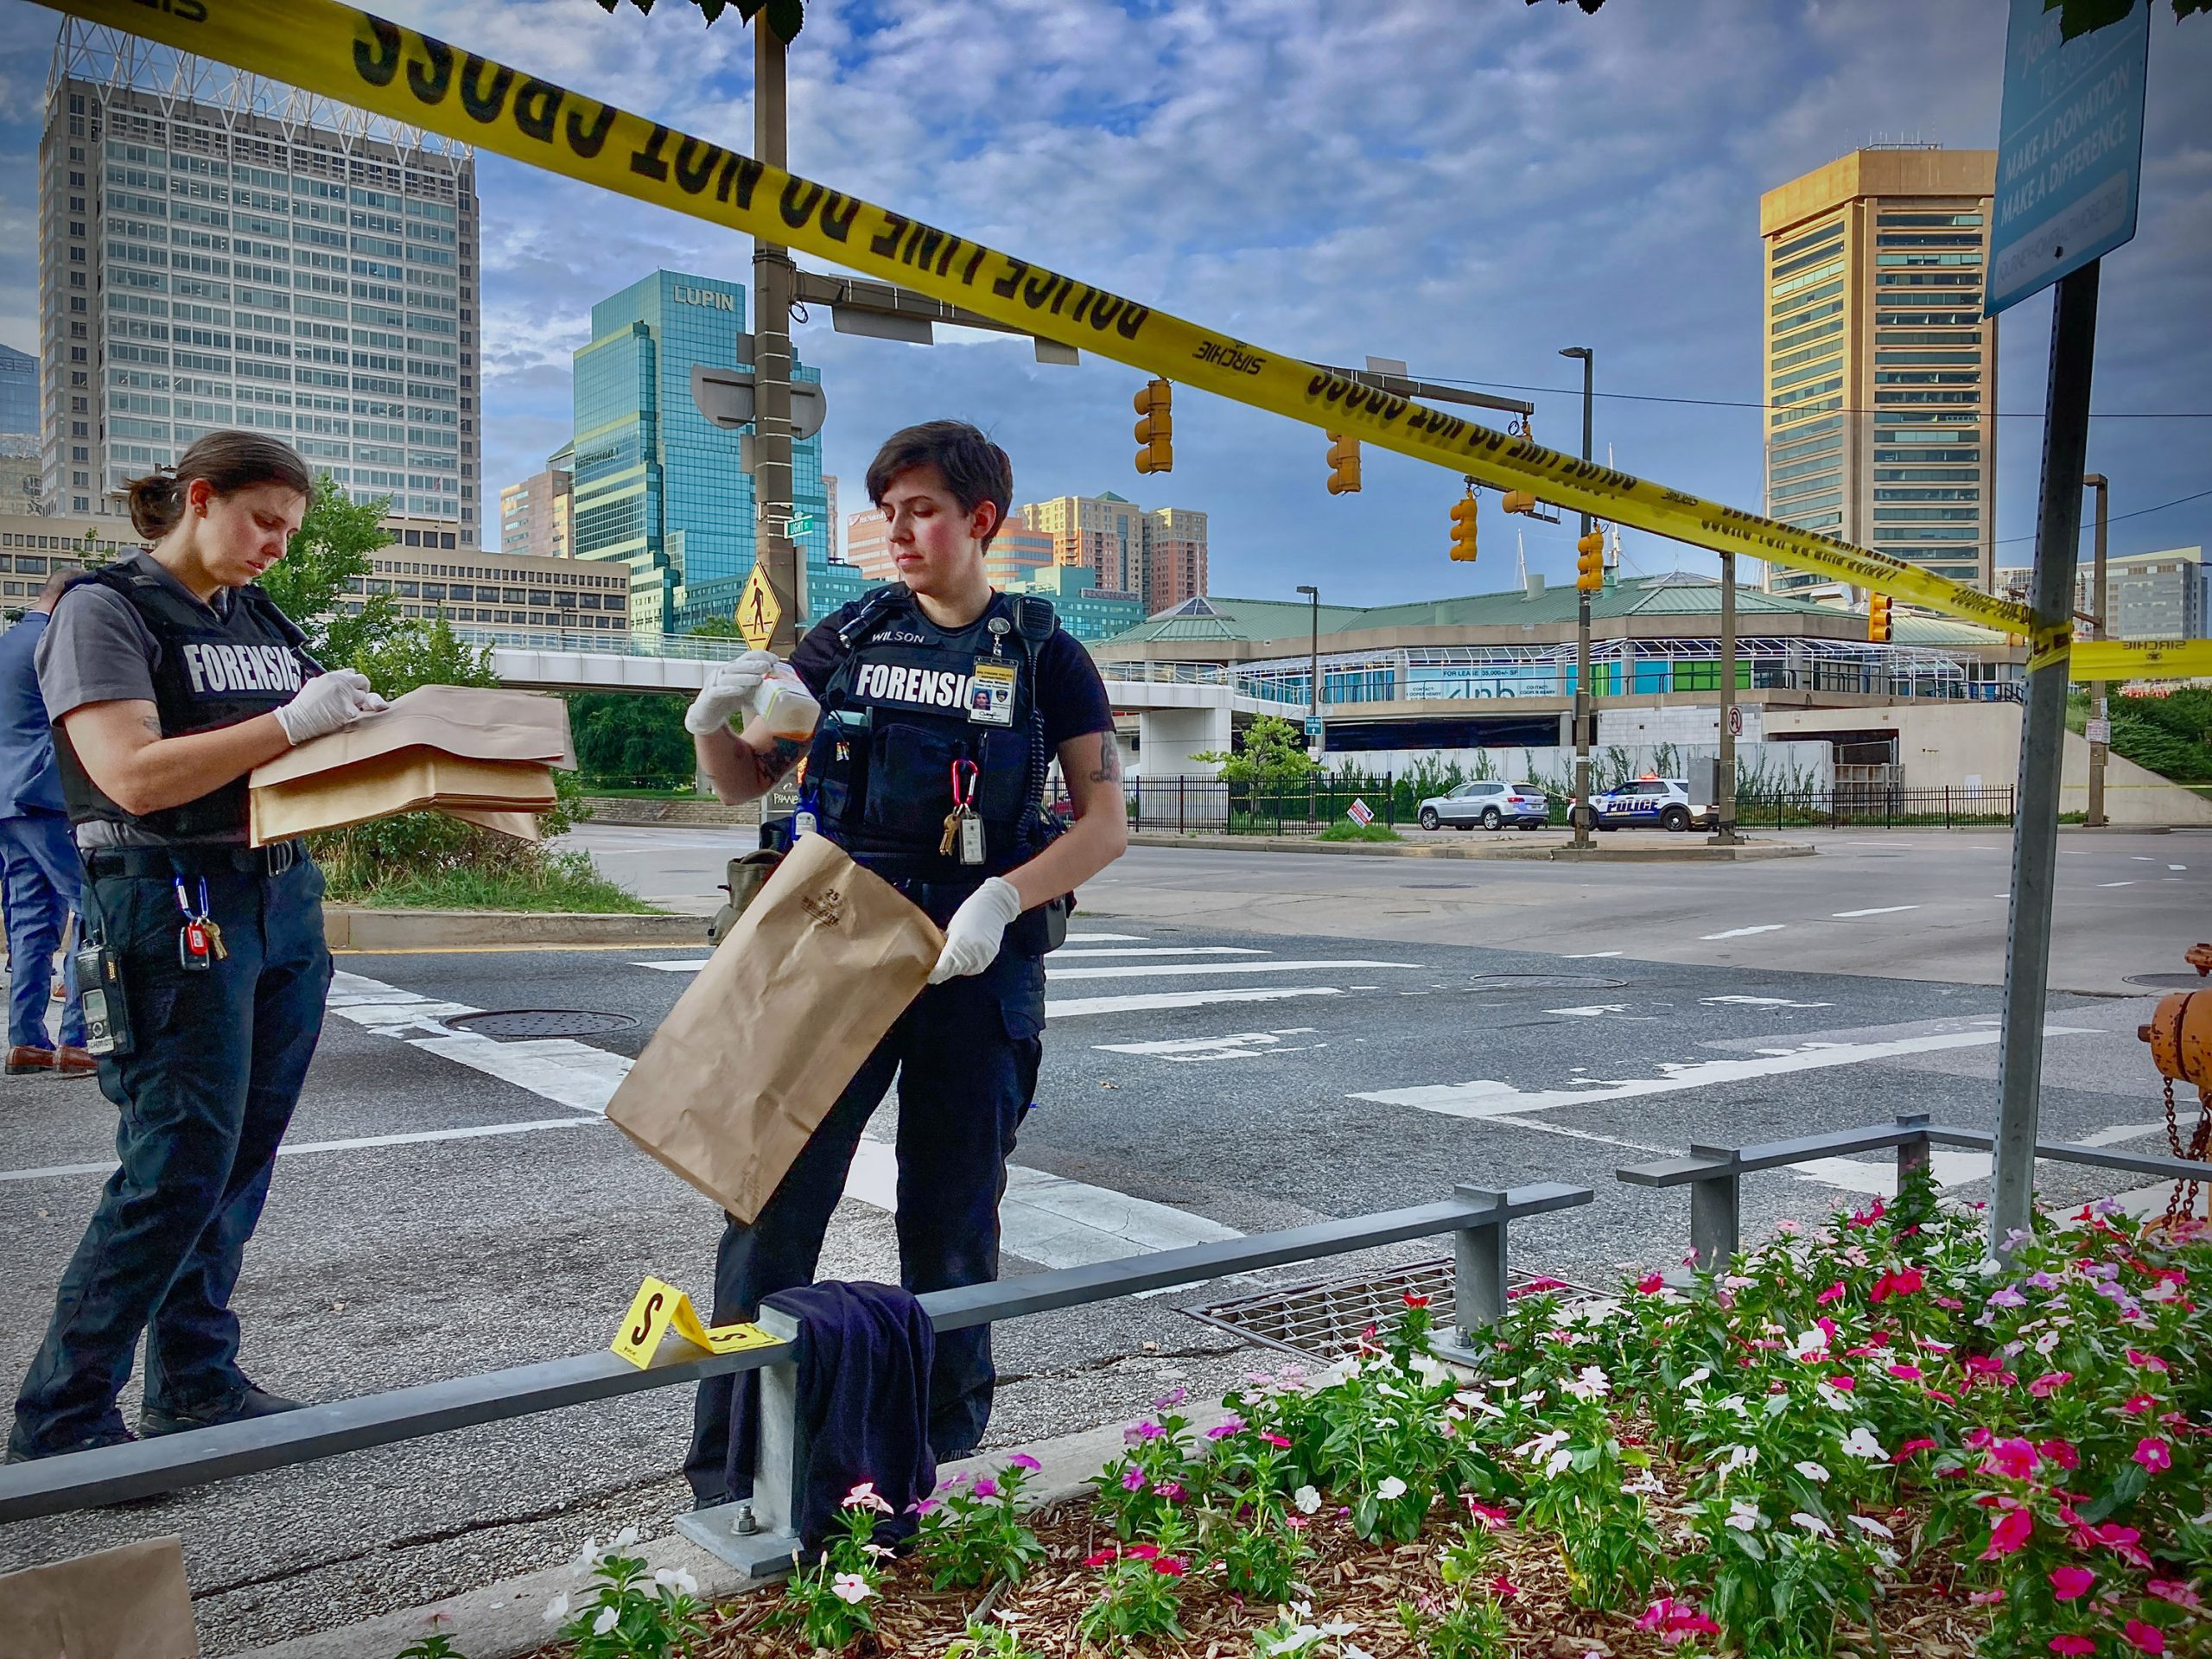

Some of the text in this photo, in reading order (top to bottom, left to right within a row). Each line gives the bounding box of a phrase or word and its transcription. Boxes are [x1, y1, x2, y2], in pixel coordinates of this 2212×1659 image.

[2004, 57, 2130, 185] MAKE A DONATION
[2000, 108, 2127, 227] MAKE A DIFFERENCE
[673, 283, 734, 312] LUPIN
[1192, 340, 1266, 376] SIRCHIE
[790, 520, 803, 533] LIGHT
[871, 631, 925, 645] WILSON
[1607, 798, 1660, 811] POLICE
